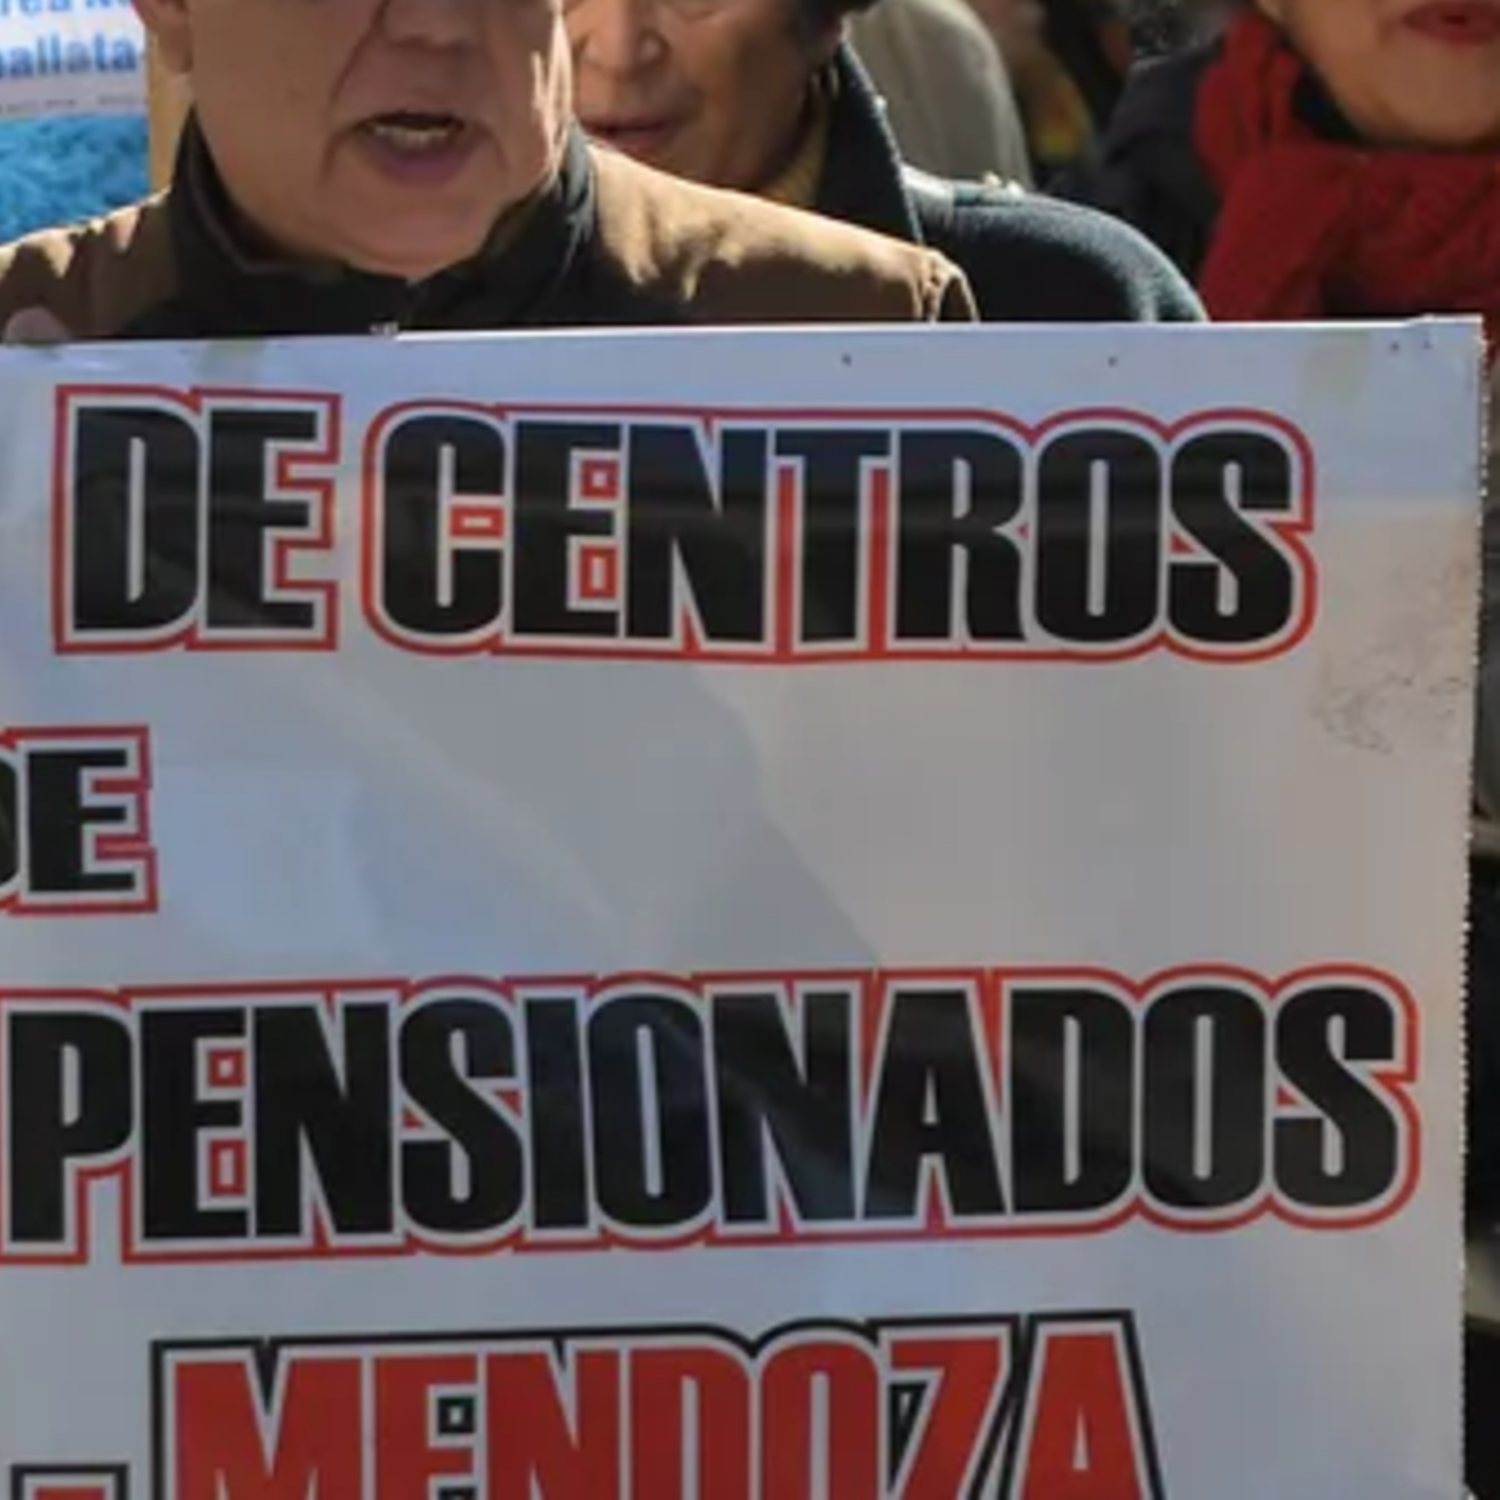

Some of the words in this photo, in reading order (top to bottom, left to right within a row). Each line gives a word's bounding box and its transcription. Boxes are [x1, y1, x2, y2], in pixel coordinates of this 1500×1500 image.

[54, 385, 340, 653] DE
[361, 399, 1318, 663] CENTROS
[152, 1310, 1164, 1500] MENDOZA
